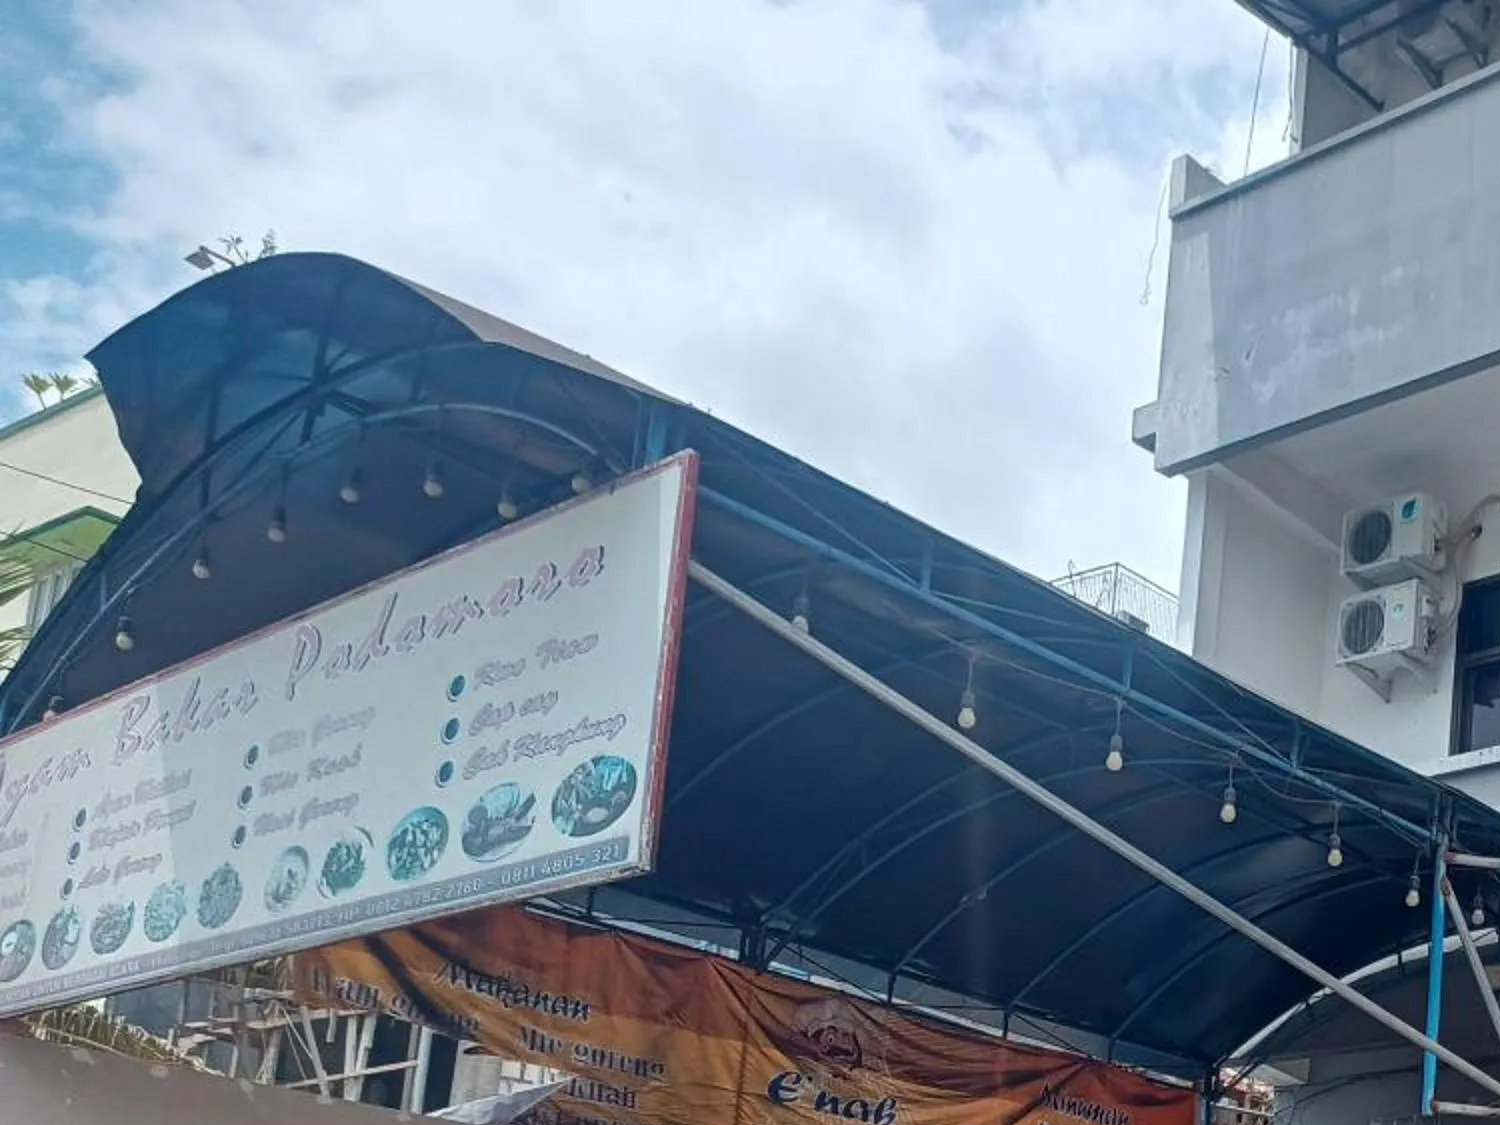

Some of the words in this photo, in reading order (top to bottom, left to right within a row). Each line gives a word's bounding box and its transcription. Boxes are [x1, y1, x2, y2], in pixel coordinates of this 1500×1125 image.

[500, 867, 536, 884] 0811
[540, 855, 585, 877] 4805
[590, 844, 622, 865] 321
[434, 960, 593, 1023] Makanan
